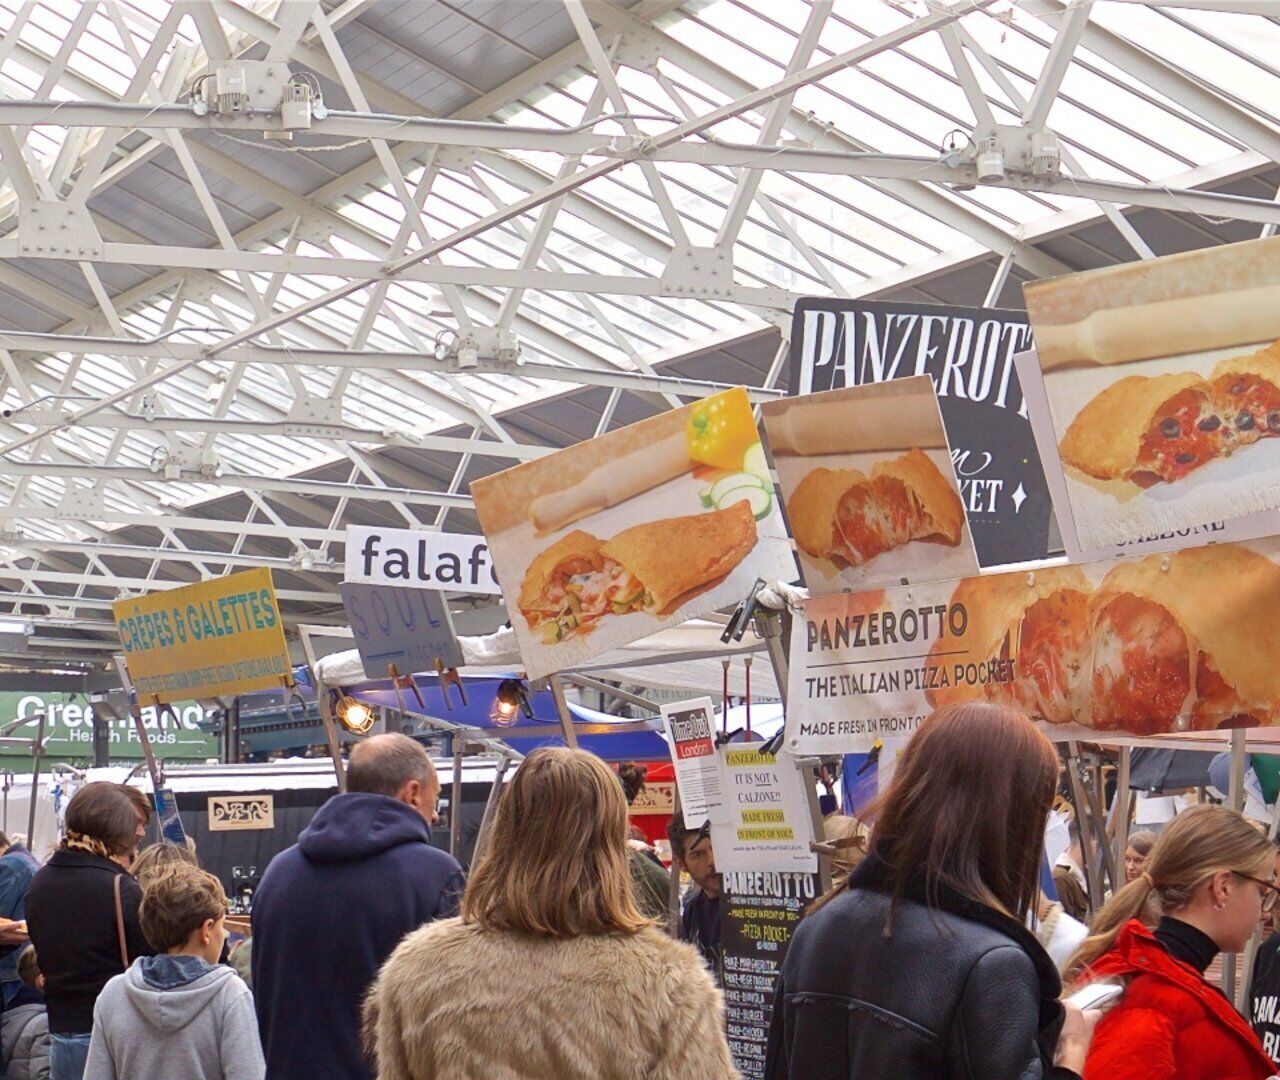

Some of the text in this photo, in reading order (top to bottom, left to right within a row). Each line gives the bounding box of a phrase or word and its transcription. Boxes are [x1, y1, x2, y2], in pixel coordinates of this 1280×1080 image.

[118, 588, 278, 652] CRÊPES & GALETTES
[806, 602, 969, 653] PANZEROTTO
[805, 658, 1016, 699] THE ITALIAN PIZZA POCKET
[799, 719, 836, 737] MADE
[837, 718, 866, 734] FRESH
[867, 717, 878, 732] IN
[879, 716, 914, 732] FRONT
[679, 742, 709, 758] London
[744, 773, 753, 784] IS
[754, 772, 772, 785] NOT
[722, 871, 816, 899] PANZEROTTO
